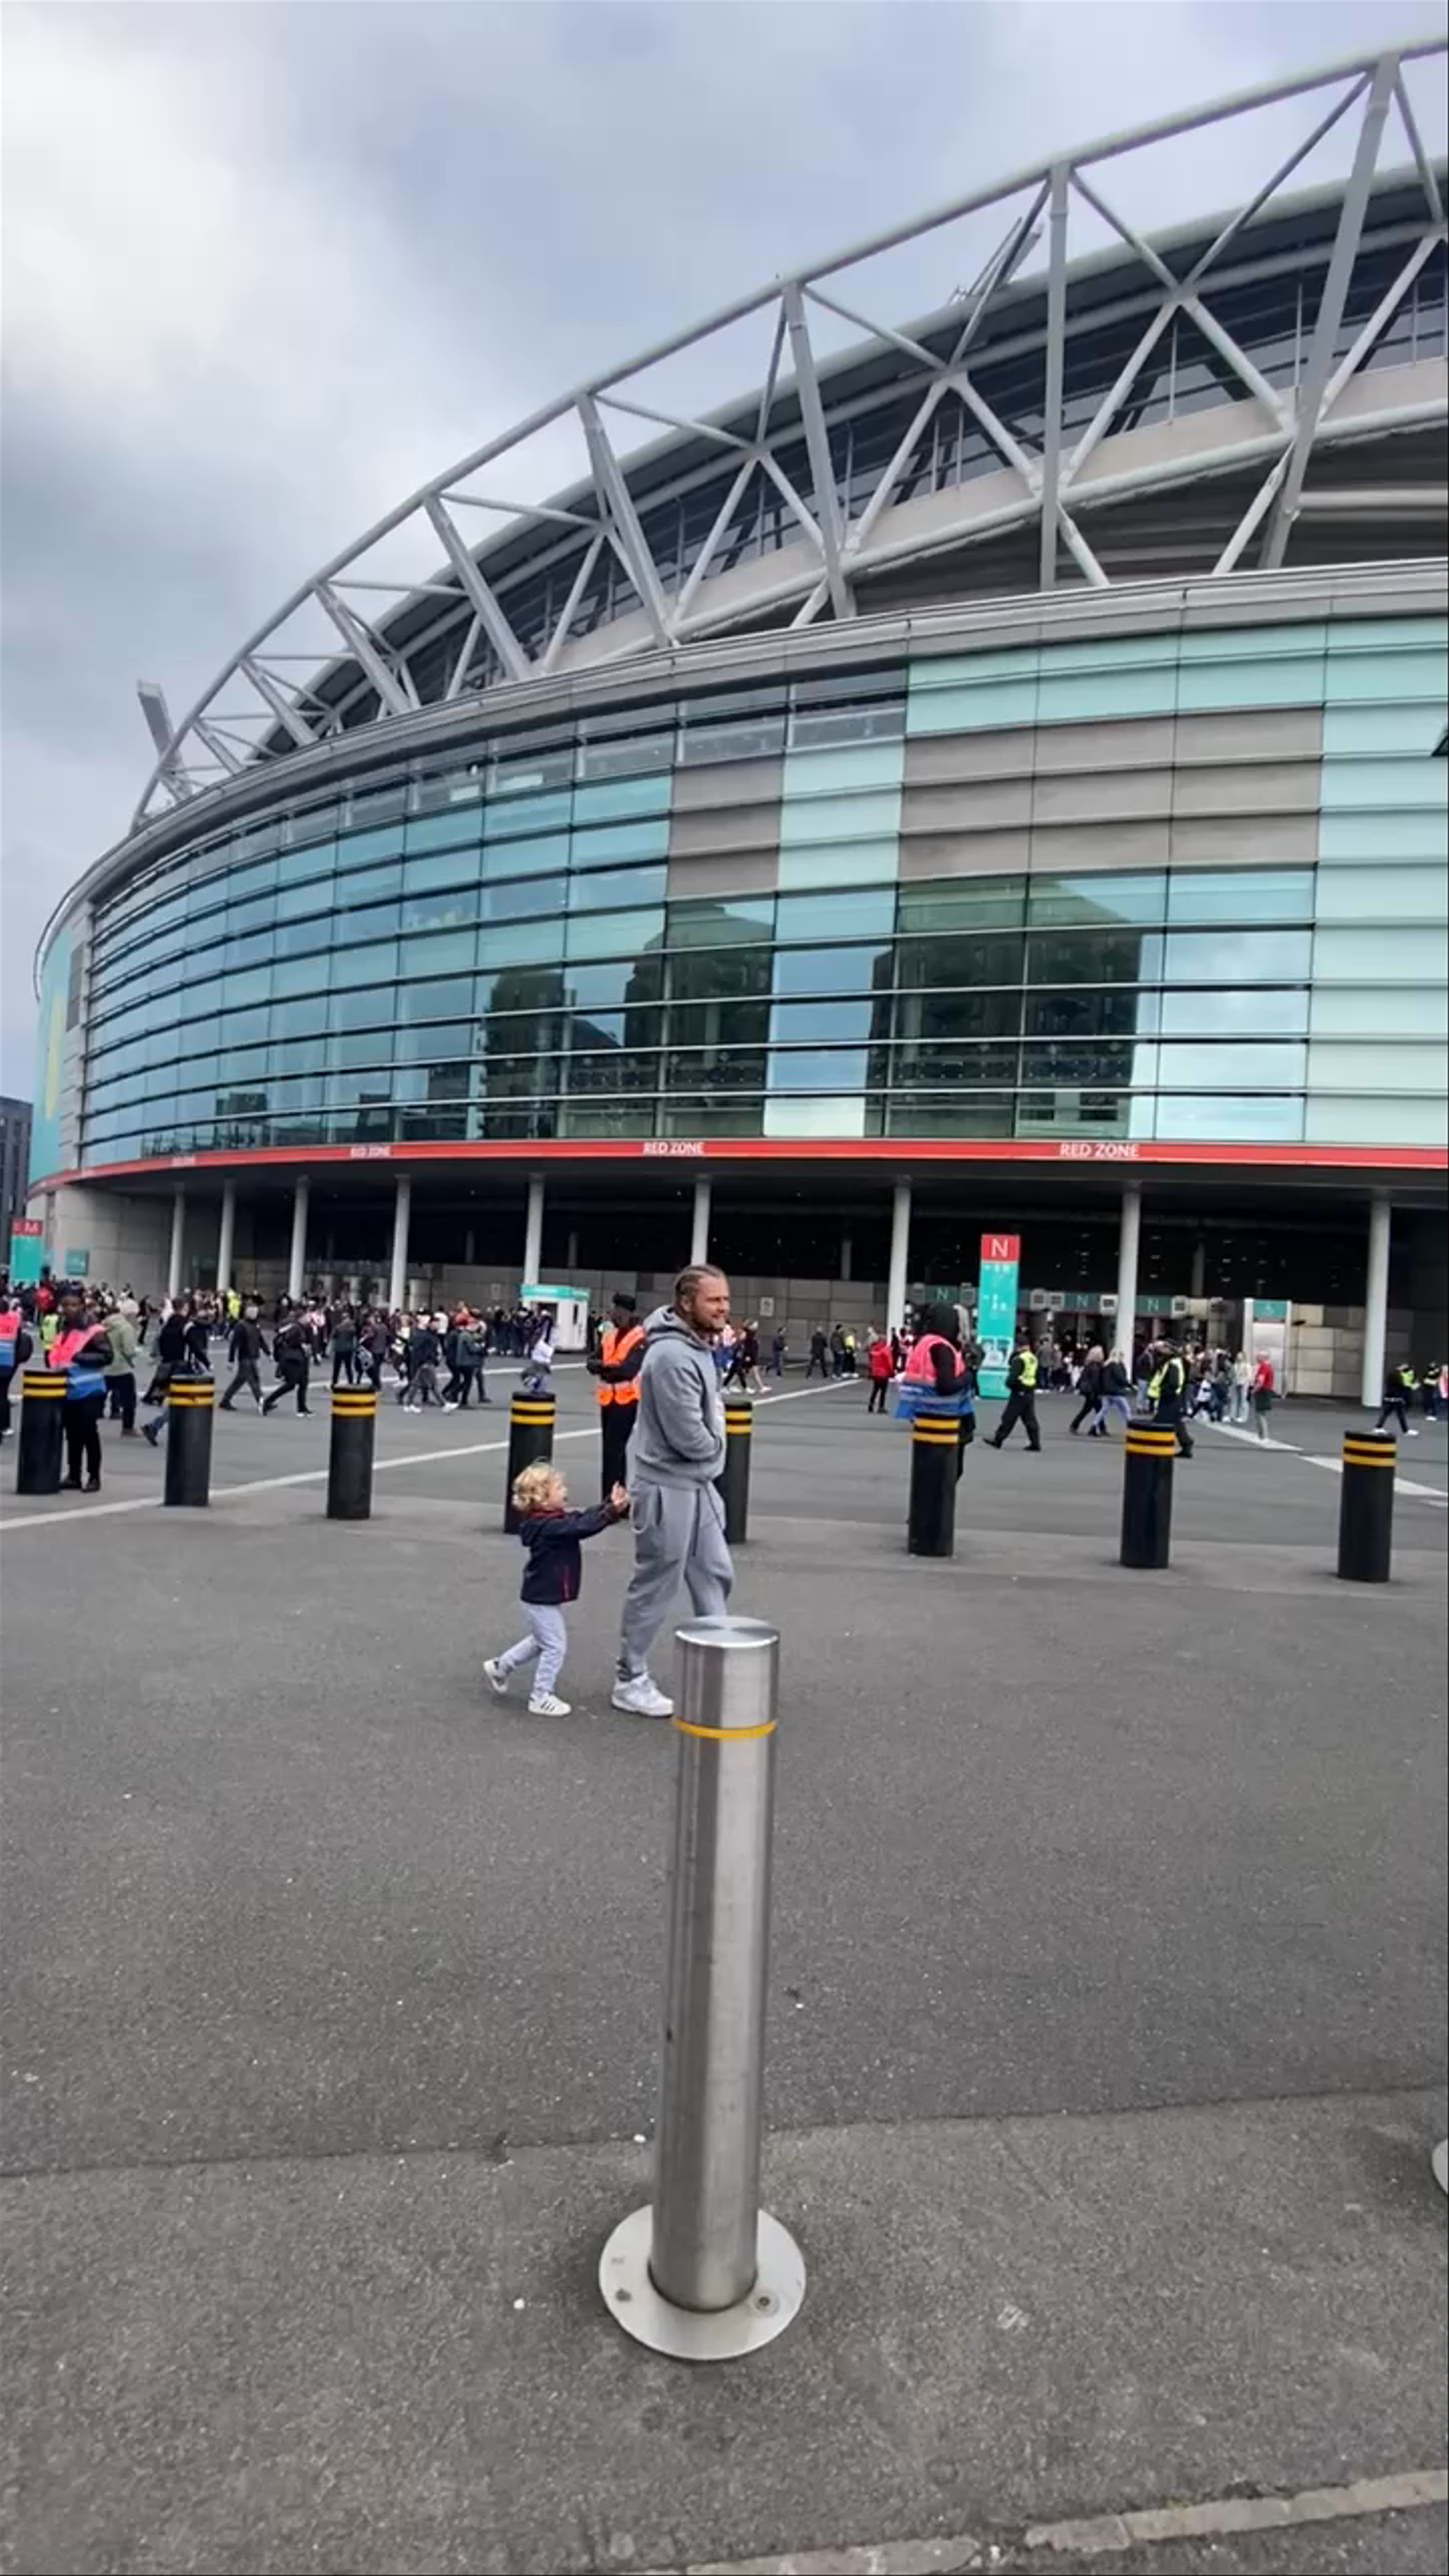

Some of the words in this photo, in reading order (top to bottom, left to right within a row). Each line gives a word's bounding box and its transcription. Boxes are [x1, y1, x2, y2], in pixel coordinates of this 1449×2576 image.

[644, 1141, 668, 1155] RED
[670, 1141, 705, 1155] ZONE
[1061, 1143, 1092, 1157] RED
[1095, 1143, 1140, 1158] ZONE
[991, 1238, 1009, 1258] N
[937, 1287, 949, 1300] N
[1077, 1295, 1088, 1308] N
[1147, 1298, 1160, 1312] N
